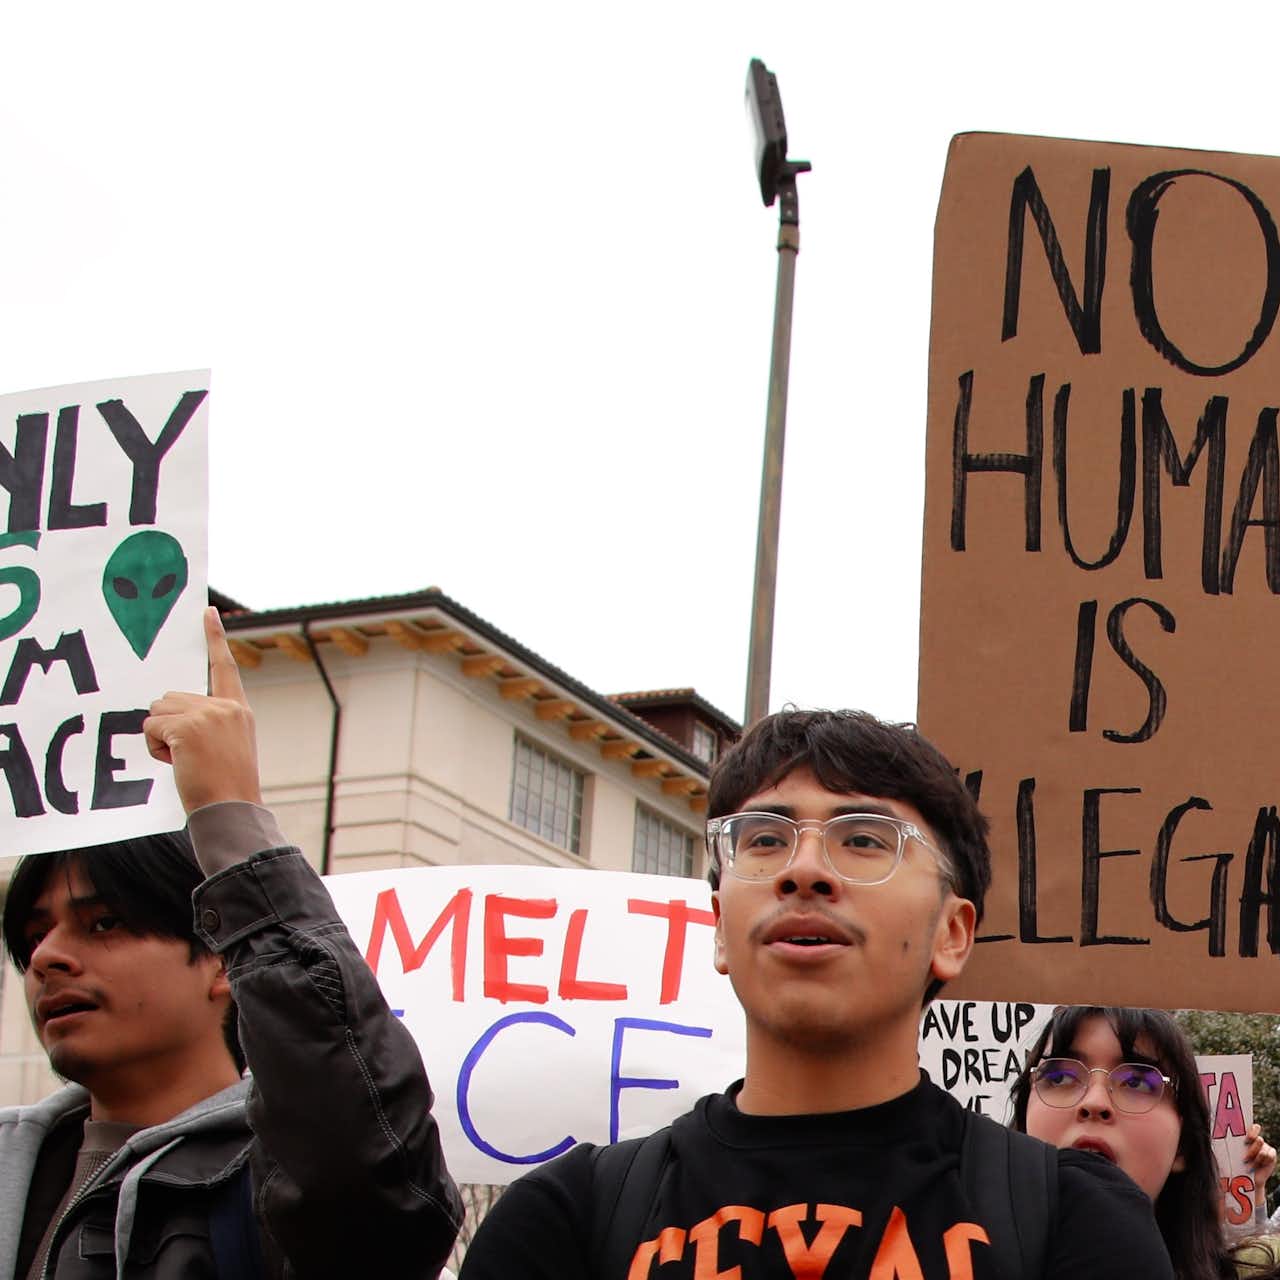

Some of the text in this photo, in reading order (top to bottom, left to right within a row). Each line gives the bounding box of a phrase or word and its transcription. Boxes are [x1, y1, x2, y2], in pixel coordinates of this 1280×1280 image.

[1068, 597, 1177, 744] IS
[366, 887, 715, 1005] MELT
[922, 1002, 1035, 1044] AVE UP
[942, 1047, 1033, 1091] DREA
[390, 1009, 713, 1165] CE
